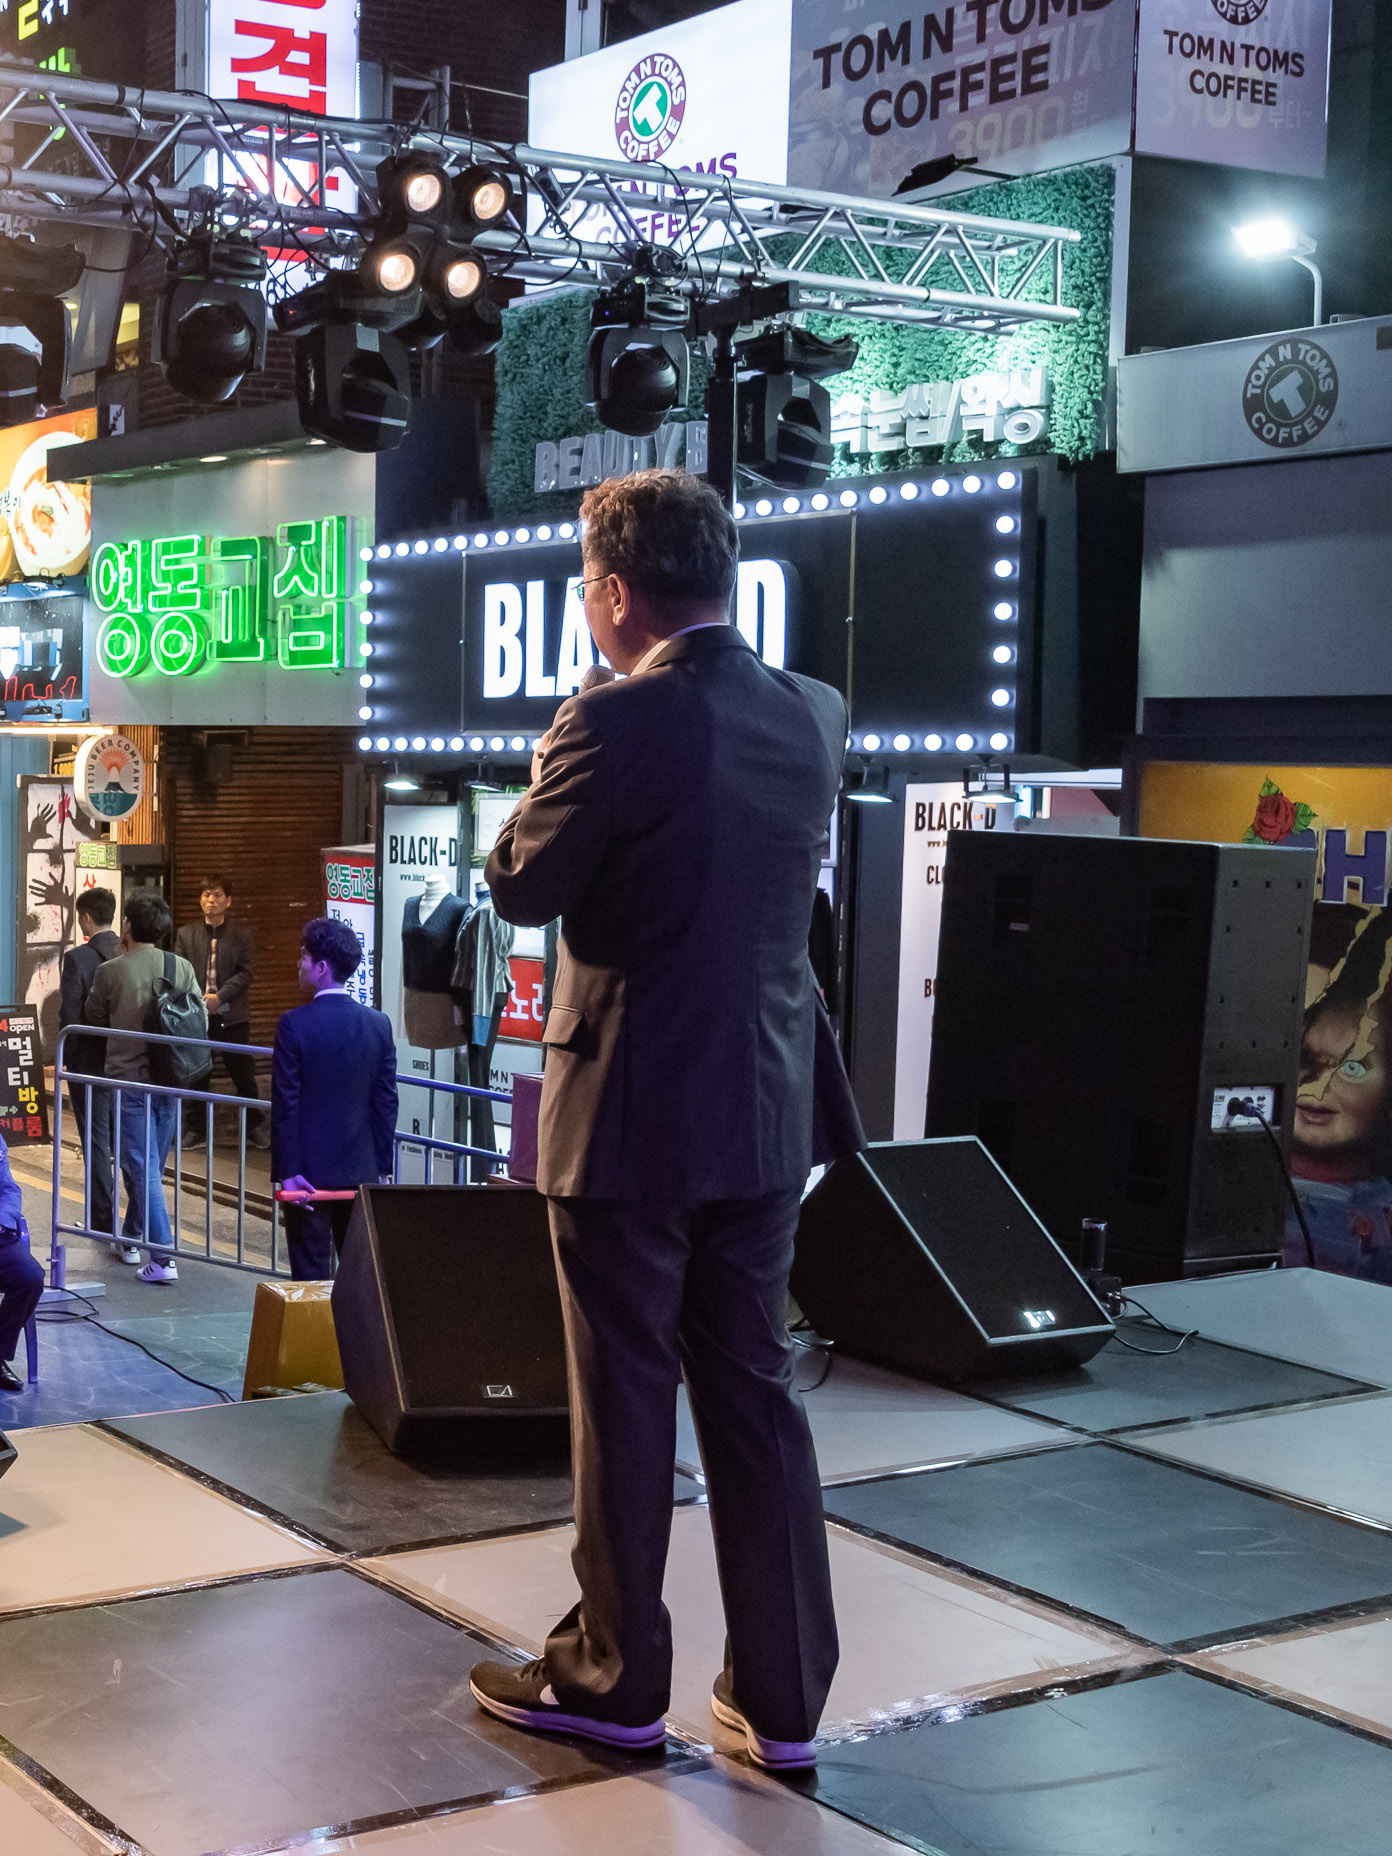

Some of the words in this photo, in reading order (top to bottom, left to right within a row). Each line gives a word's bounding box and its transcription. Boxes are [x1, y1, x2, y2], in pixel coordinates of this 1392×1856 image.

[814, 22, 911, 89] TOM
[923, 7, 954, 60] N
[1163, 29, 1214, 62] TOM
[1220, 40, 1235, 66] N
[1240, 43, 1305, 78] TOMS
[616, 73, 639, 123] TOM
[637, 58, 652, 78] N
[654, 55, 685, 106] TOMS
[863, 44, 1050, 136] COFFEE
[1189, 69, 1277, 106] COFFEE
[619, 117, 681, 162] COFFEE
[1247, 353, 1276, 398] TOM
[1278, 344, 1292, 361] N
[1298, 343, 1334, 393] TOMS
[1251, 405, 1329, 443] COFFEE
[534, 422, 688, 493] BEAUTY
[91, 740, 113, 761] BEER
[116, 740, 140, 791] COMPANY
[914, 801, 996, 832] BLACK-D
[9, 1024, 35, 1034] OPEN
